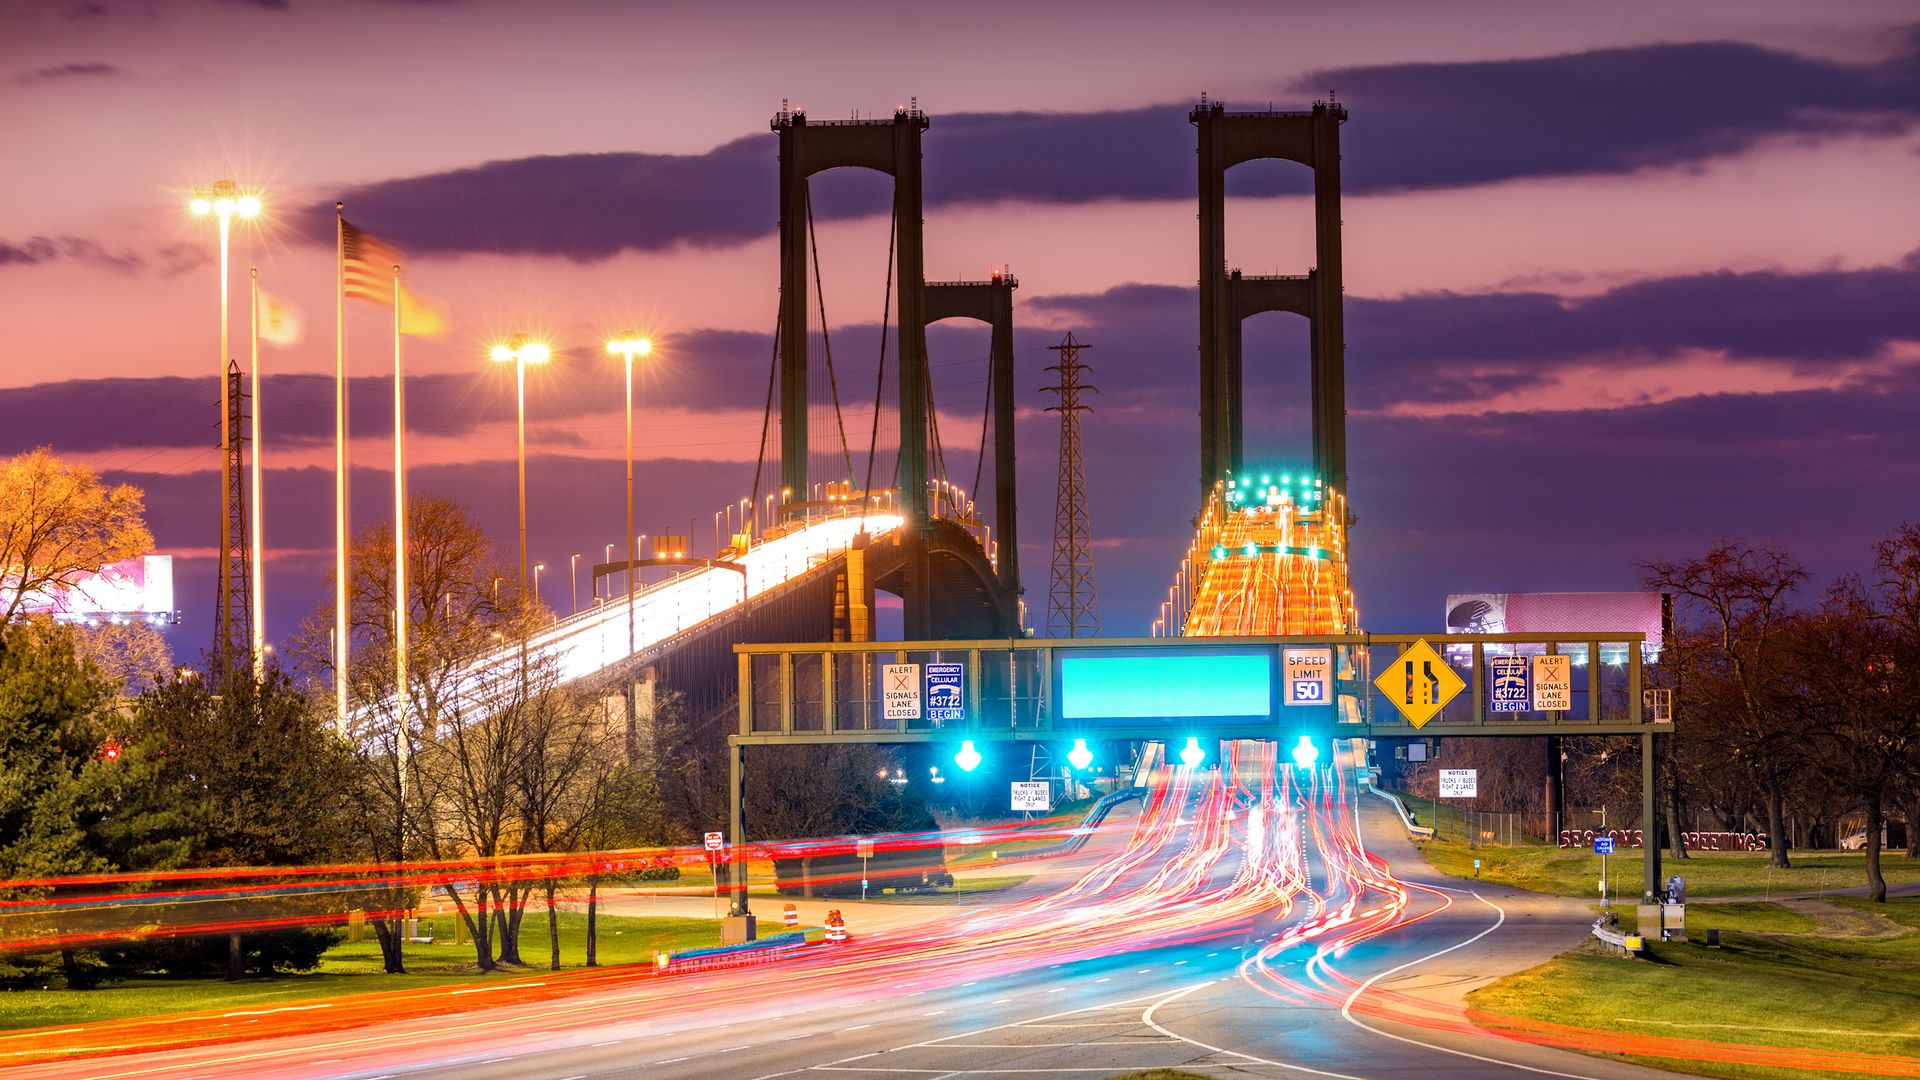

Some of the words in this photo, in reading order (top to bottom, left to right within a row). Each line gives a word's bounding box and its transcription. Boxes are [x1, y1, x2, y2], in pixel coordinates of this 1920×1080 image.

[1288, 656, 1327, 666] SPEED
[1539, 657, 1563, 665] ALERT
[889, 666, 913, 674] ALERT
[1293, 669, 1322, 679] LIMIT
[1296, 681, 1319, 700] 50
[1495, 688, 1526, 698] #3722
[885, 691, 918, 700] SIGNALS
[891, 700, 912, 708] LANE
[929, 696, 960, 706] #3722
[1537, 700, 1568, 708] CLOSED
[1495, 702, 1526, 711] BEGIN
[887, 709, 917, 717] CLOSED
[930, 710, 961, 718] BEGIN
[1559, 829, 1643, 849] SEAONS
